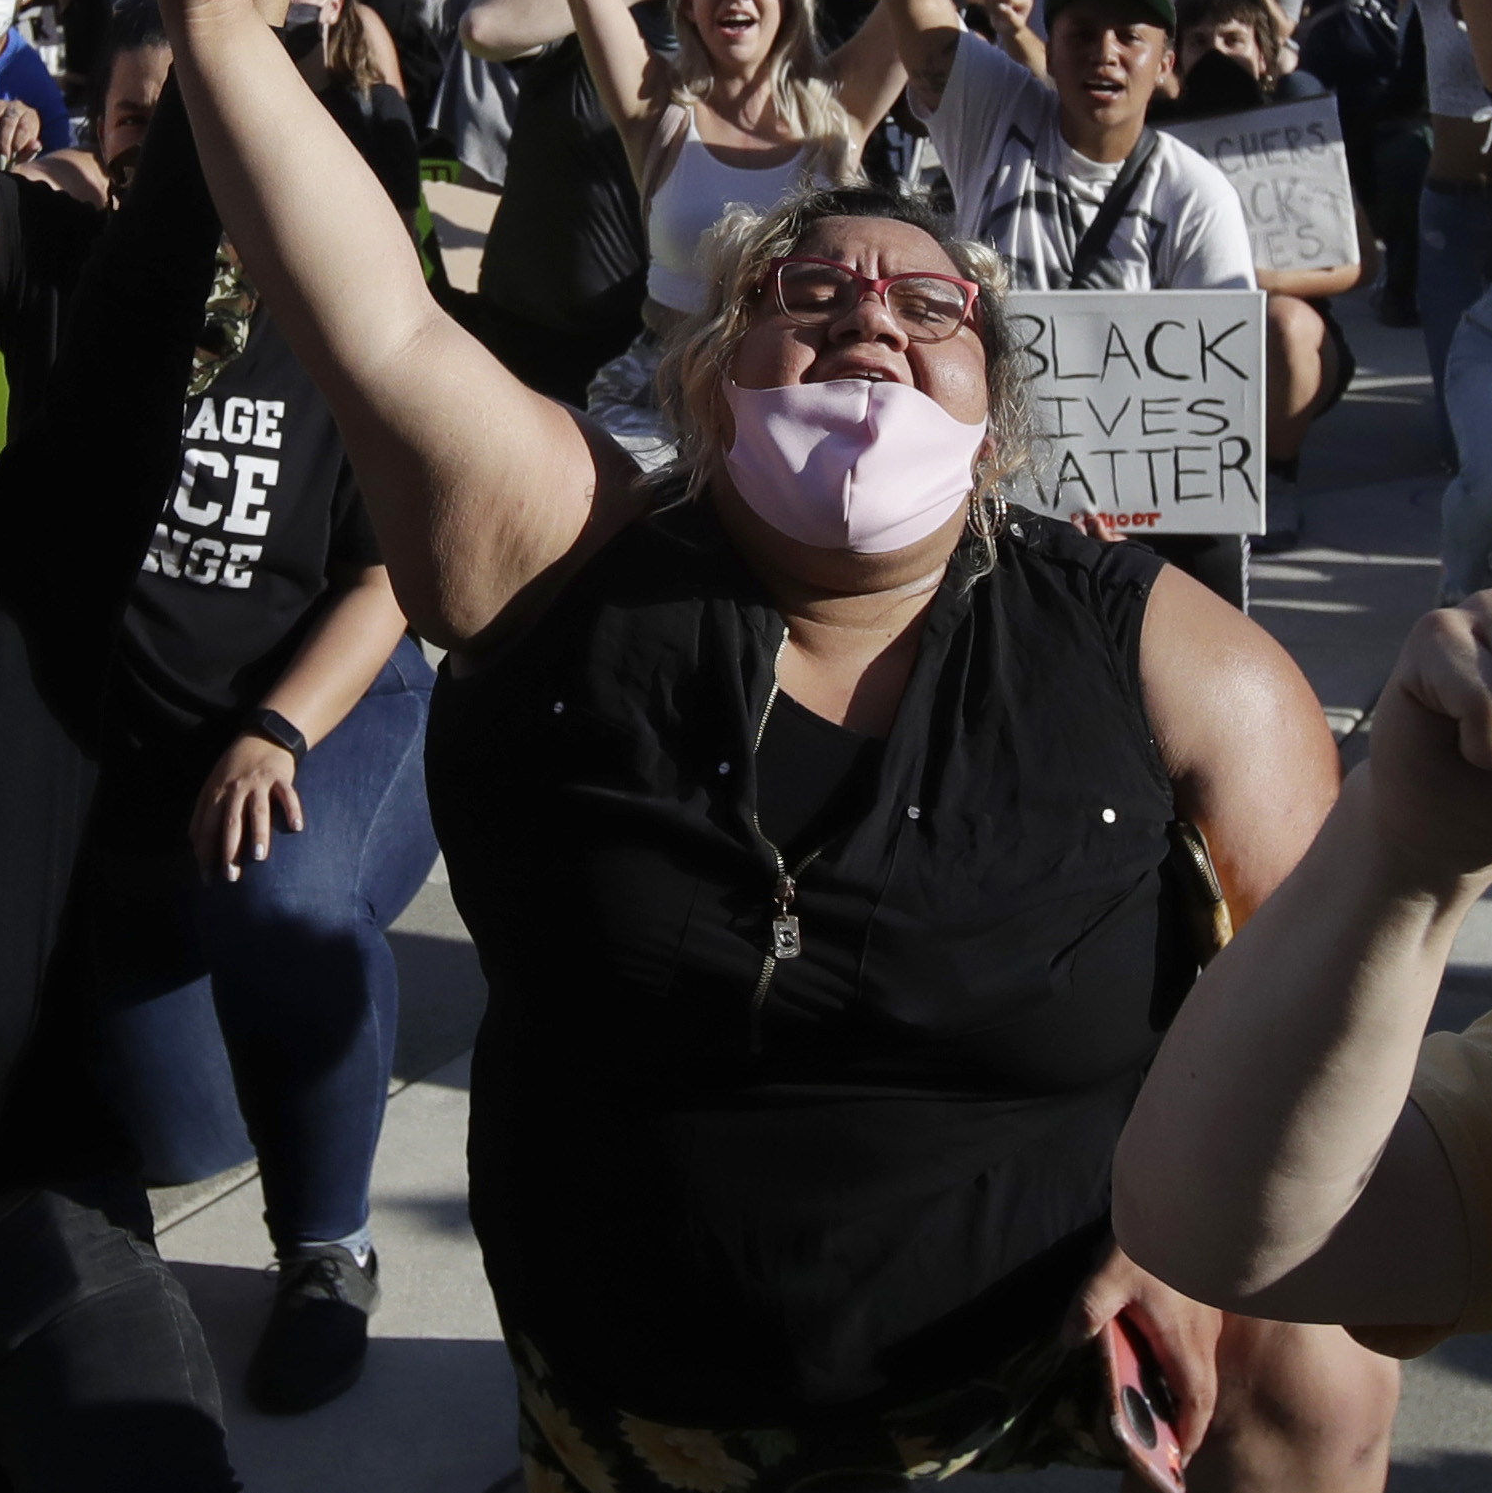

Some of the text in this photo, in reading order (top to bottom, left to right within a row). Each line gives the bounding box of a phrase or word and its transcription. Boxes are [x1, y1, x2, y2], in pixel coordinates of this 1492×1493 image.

[182, 396, 286, 450] AGE
[1036, 395, 1232, 440] IVES
[164, 447, 281, 537] CE
